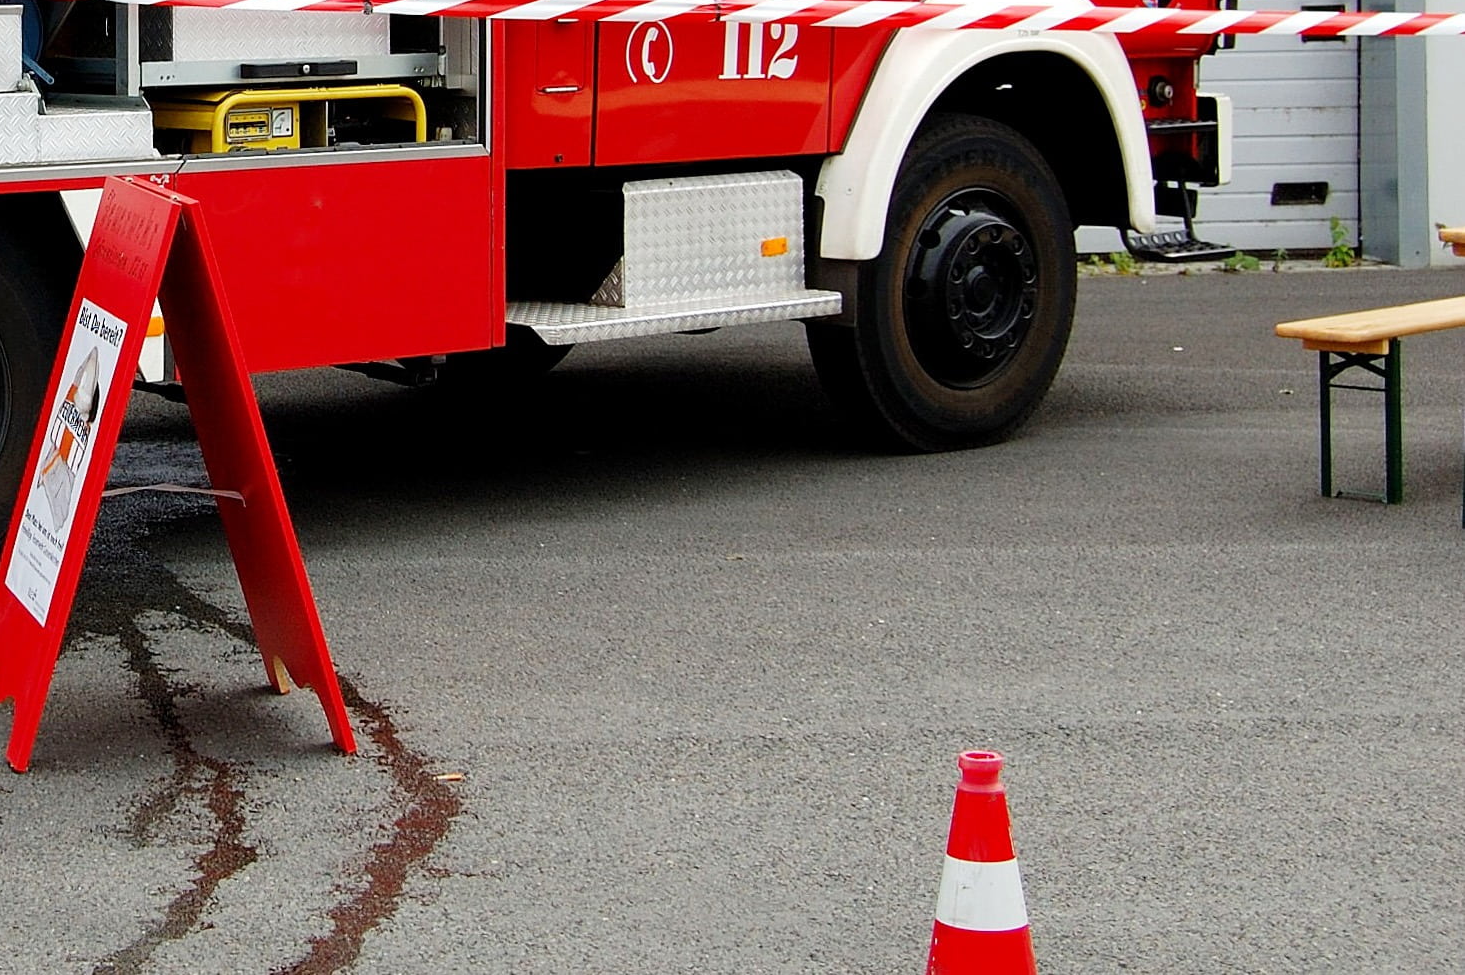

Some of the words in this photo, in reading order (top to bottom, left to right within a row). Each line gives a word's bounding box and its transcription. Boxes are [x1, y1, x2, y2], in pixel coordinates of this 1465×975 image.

[718, 20, 799, 80] 112
[79, 307, 92, 329] Bist
[90, 313, 101, 334] Du
[99, 317, 124, 347] bereit?
